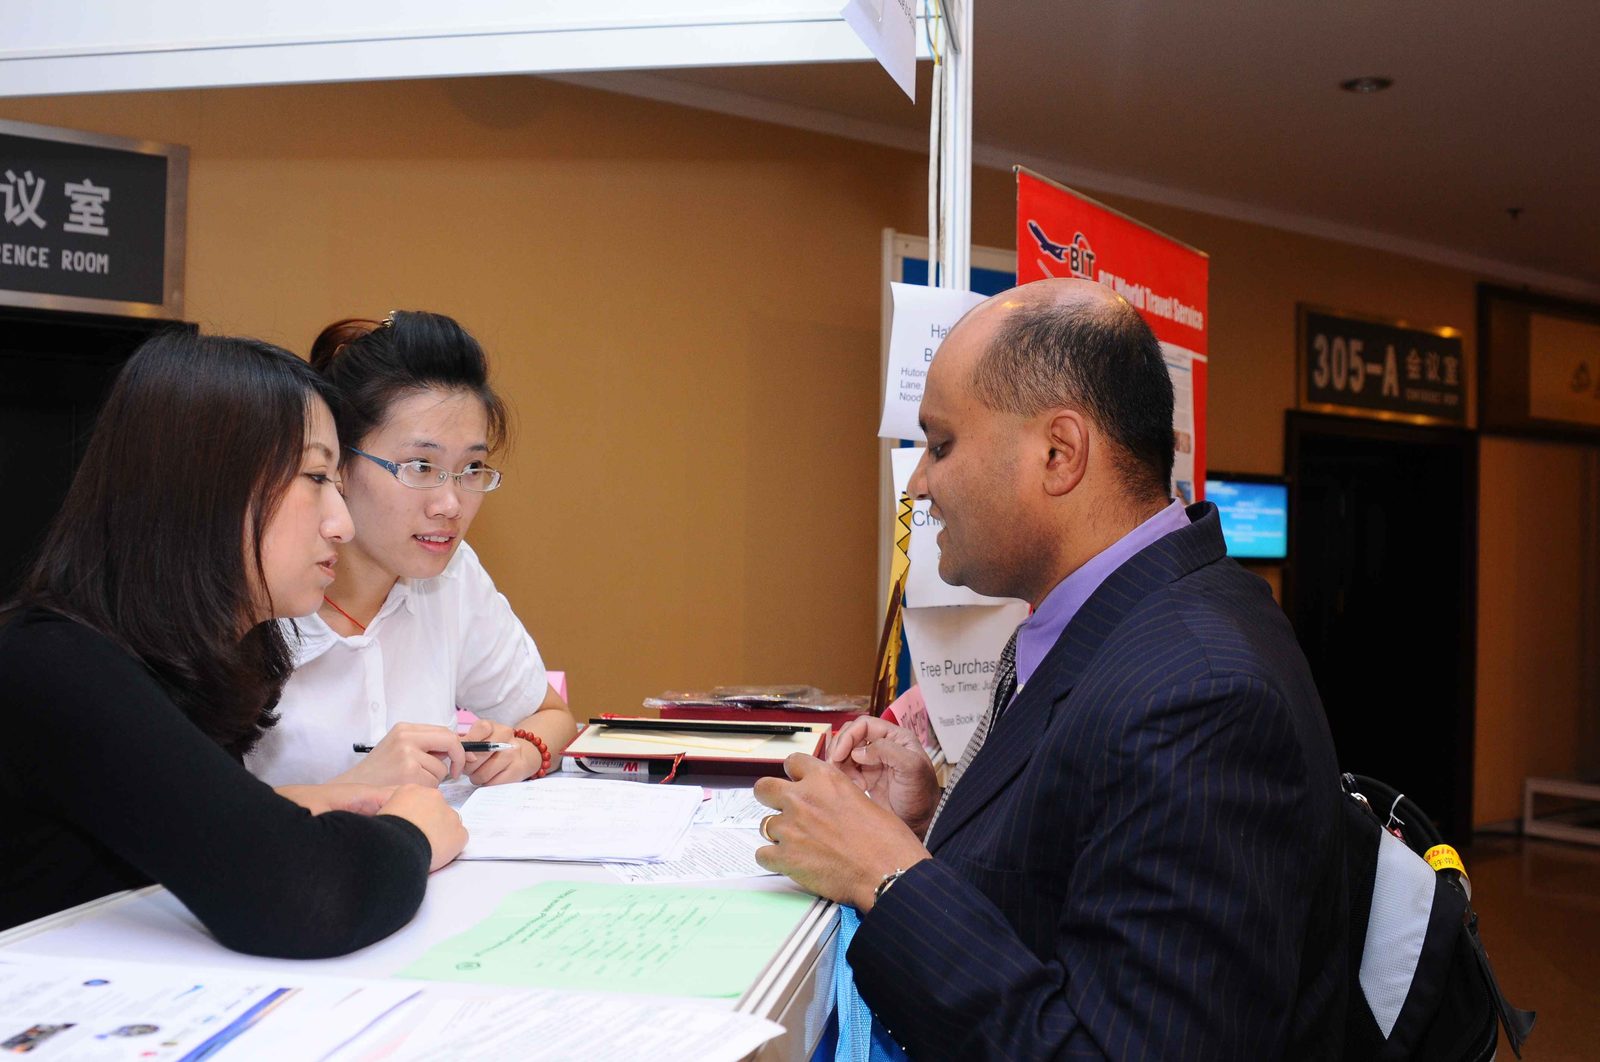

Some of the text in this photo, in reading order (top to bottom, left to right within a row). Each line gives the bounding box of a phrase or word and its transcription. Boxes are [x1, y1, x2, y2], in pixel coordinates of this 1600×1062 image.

[0, 243, 109, 275] ENCE ROOM
[1069, 244, 1095, 278] BIT
[1145, 287, 1173, 320] Travel
[1173, 298, 1204, 332] Service
[900, 367, 927, 377] Huton
[1312, 332, 1400, 398] 305-A
[912, 510, 941, 527] Ch
[920, 658, 998, 678] Free Purchas
